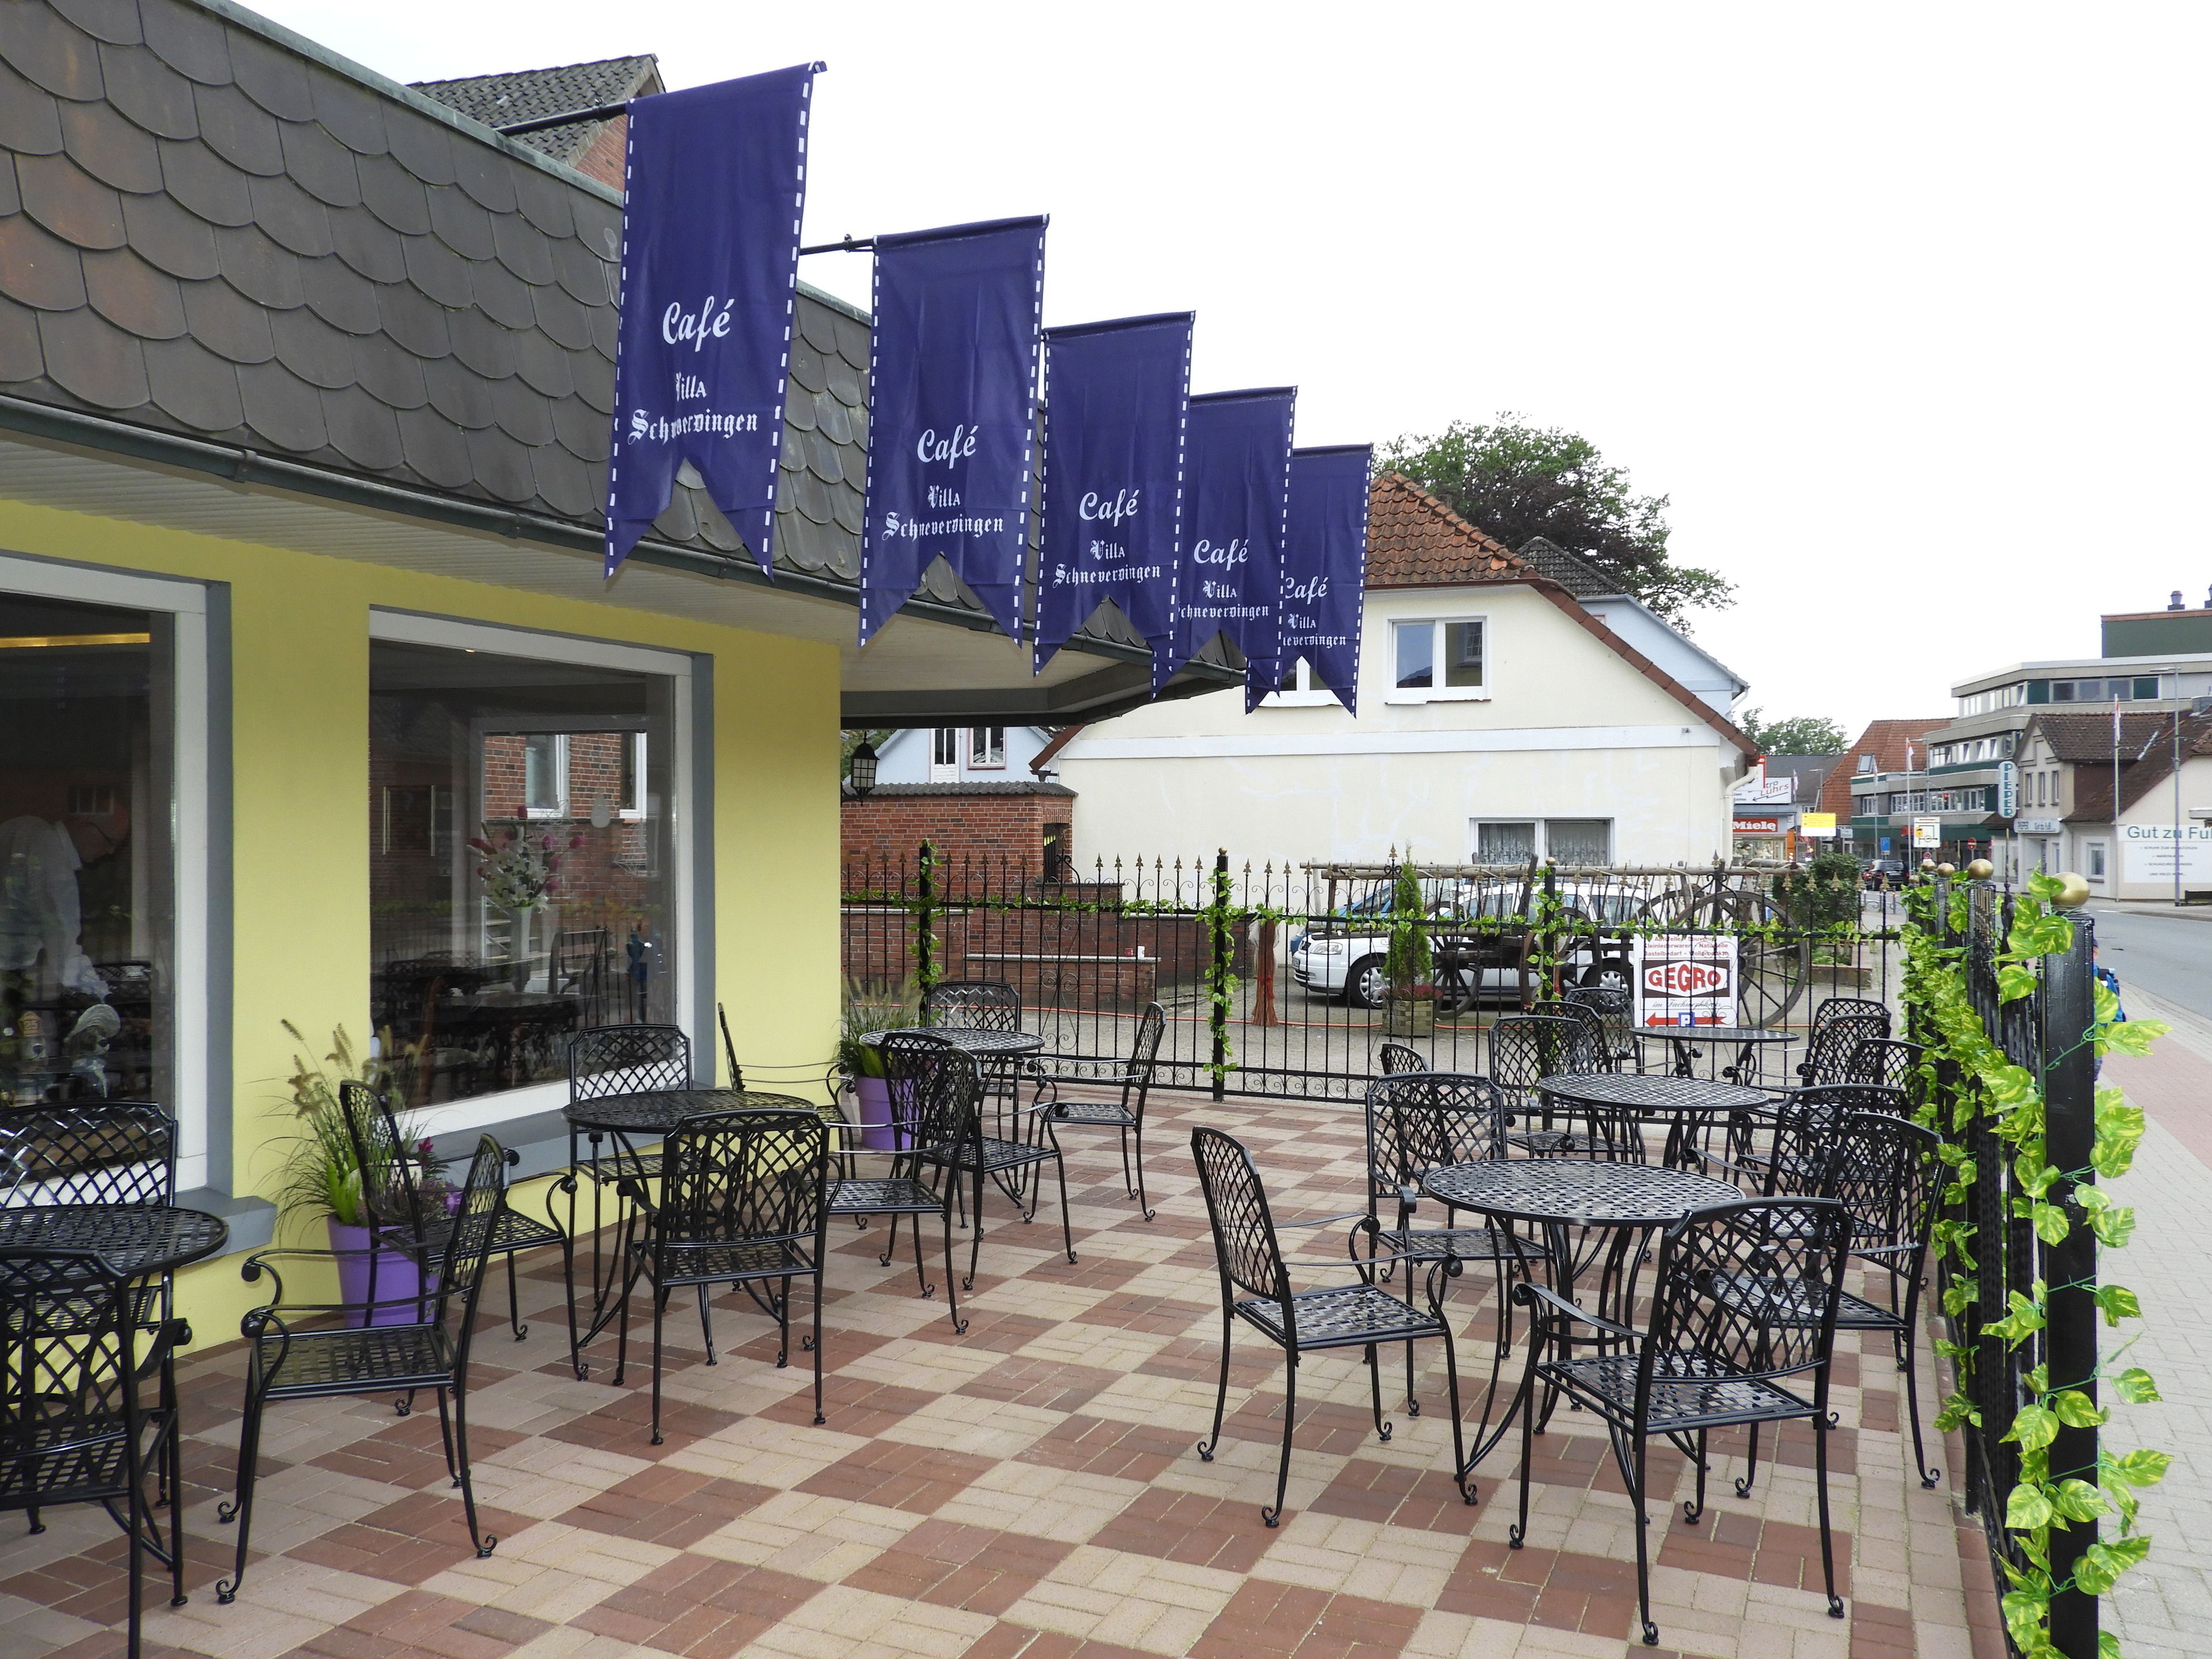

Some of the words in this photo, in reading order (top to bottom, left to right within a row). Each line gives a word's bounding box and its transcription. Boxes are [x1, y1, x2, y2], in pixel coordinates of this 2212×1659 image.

[662, 296, 735, 353] Café
[627, 408, 758, 445] Schnverdingen
[917, 424, 979, 469] Café
[1079, 488, 1139, 527] Café
[881, 512, 1003, 542] Schneverdingen
[1194, 538, 1249, 571] Café
[1052, 563, 1161, 589] Schneverdingen
[1285, 576, 1329, 605] Café
[1178, 601, 1269, 621] chneverdingen
[1283, 633, 1346, 649] everdingen
[2003, 763, 2013, 817] PIEPER
[1733, 821, 1777, 831] Miele
[2127, 826, 2158, 839] Gut
[2163, 830, 2182, 839] zu
[2189, 827, 2212, 839] Fu
[1648, 964, 1721, 992] GEGRO
[1668, 999, 1721, 1007] Fachwerkhas
[1680, 1014, 1691, 1027] P
